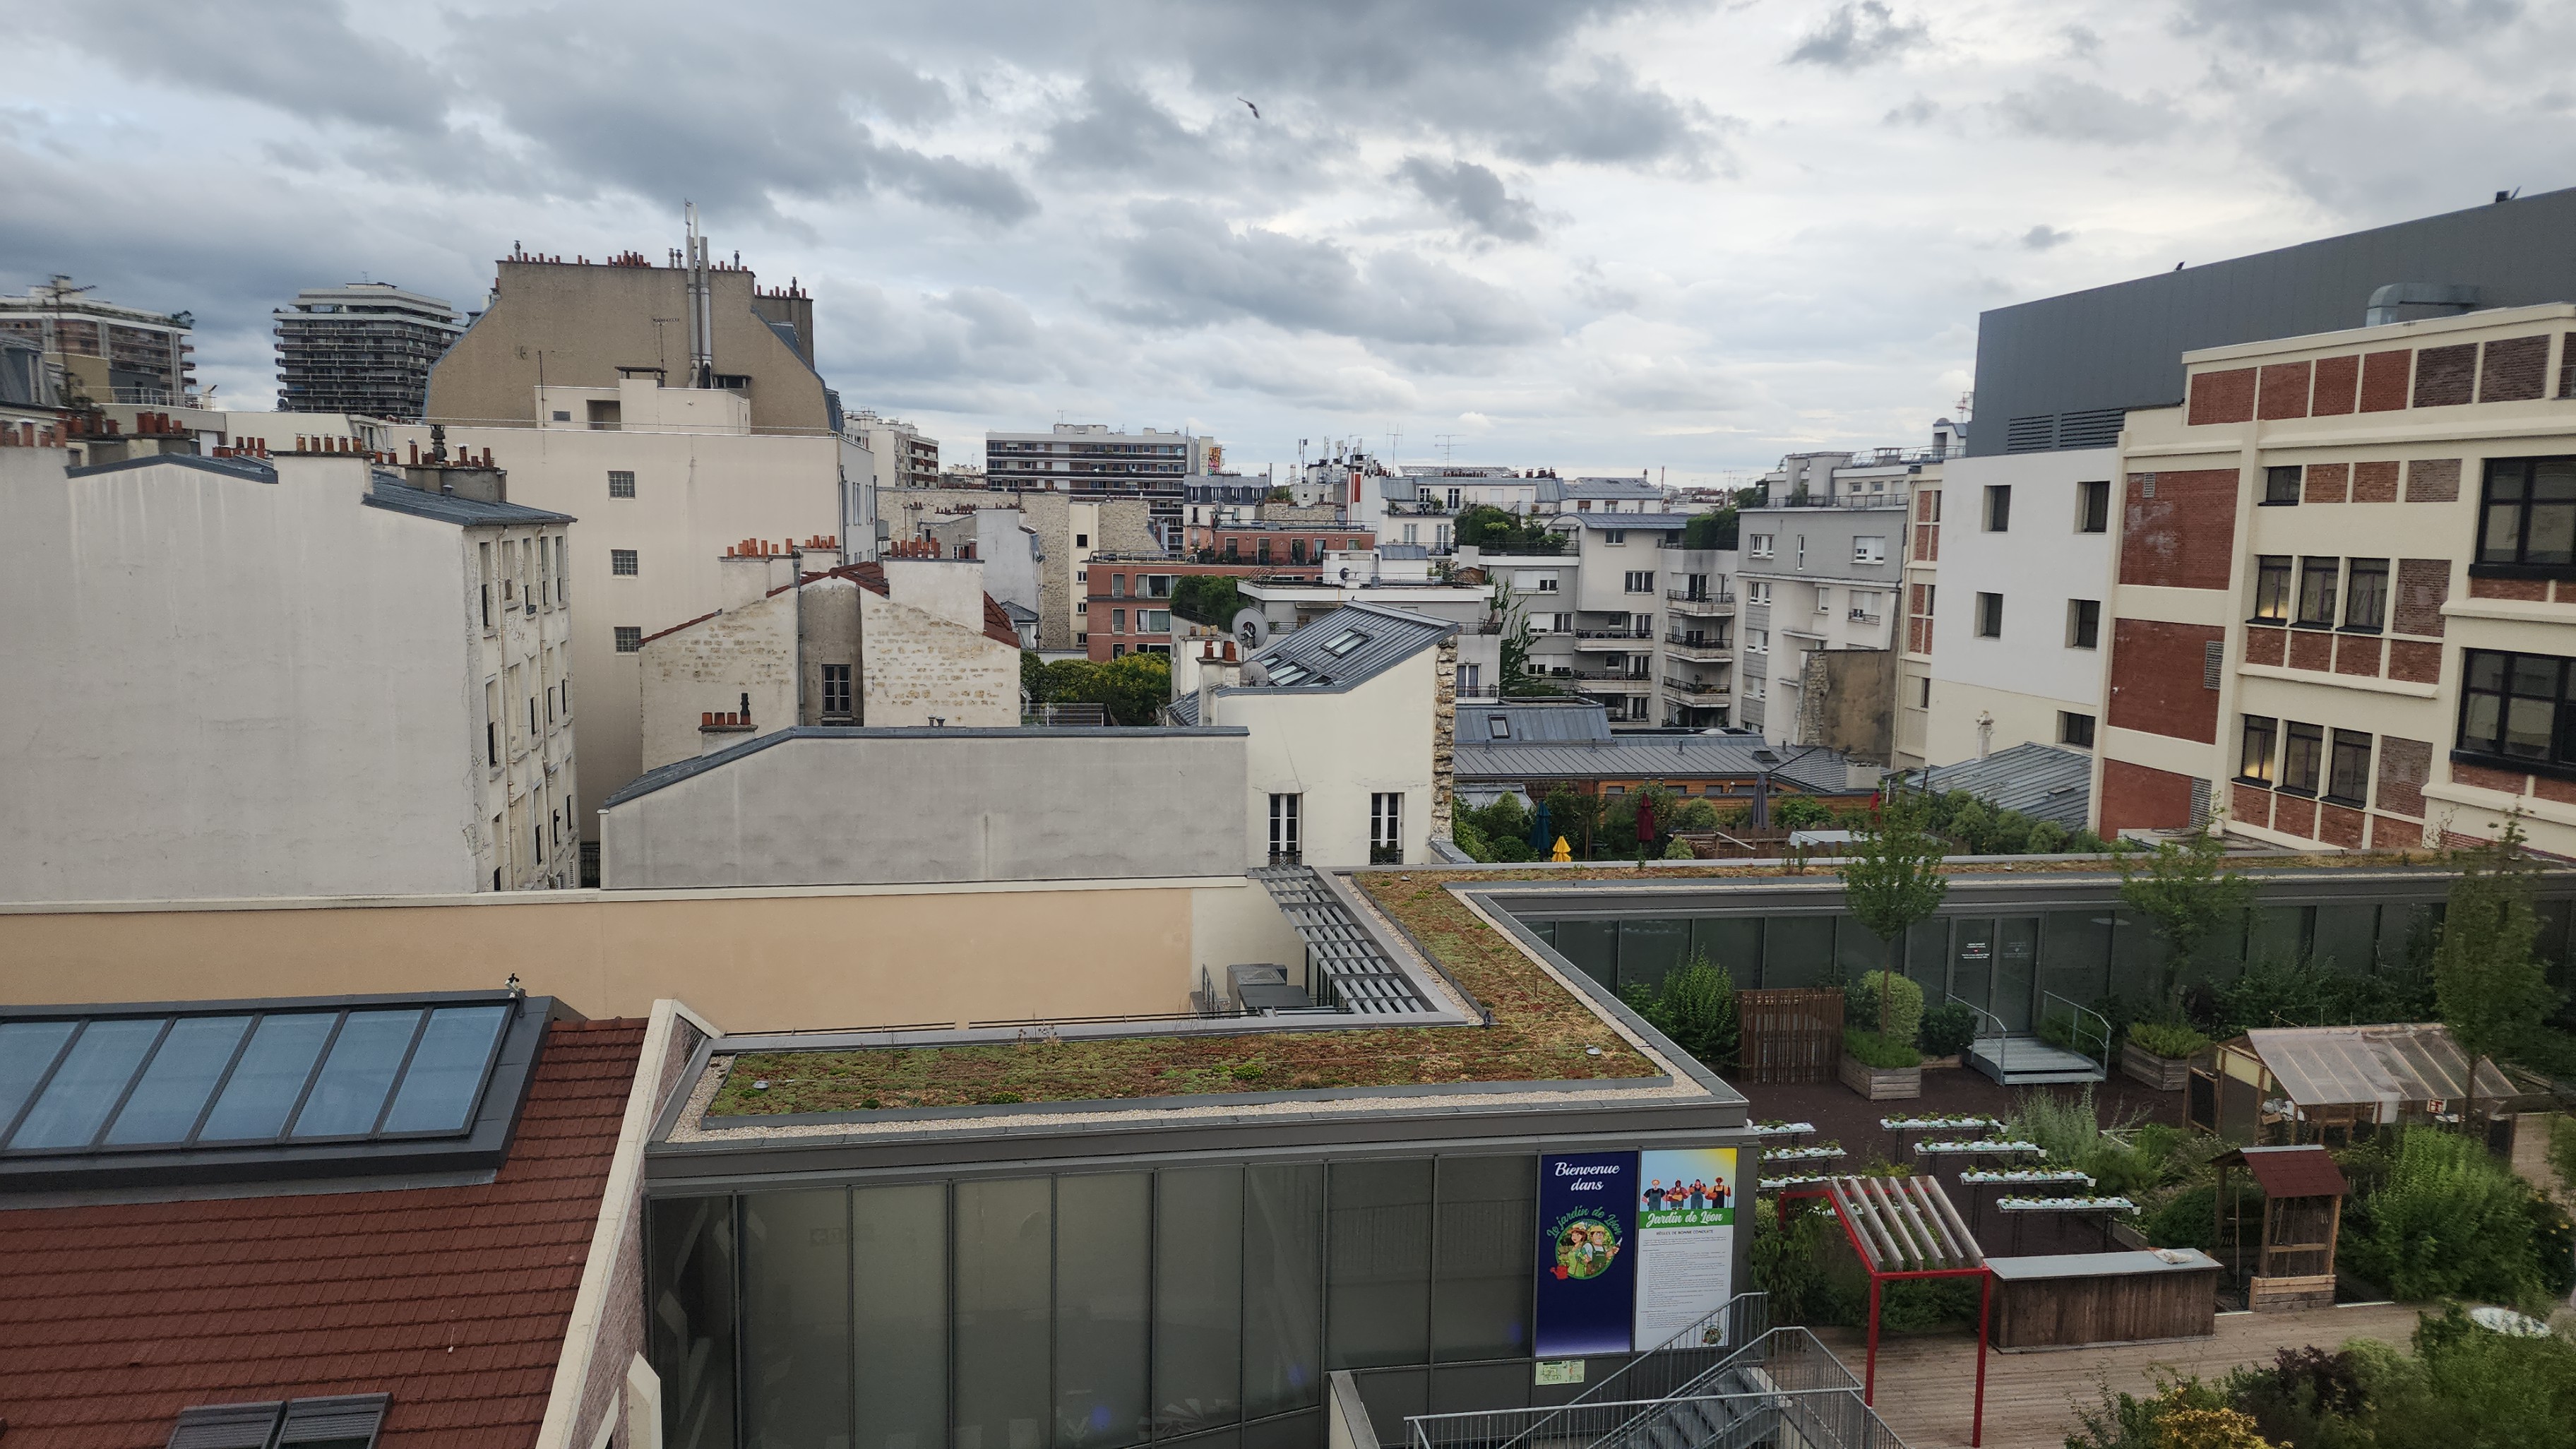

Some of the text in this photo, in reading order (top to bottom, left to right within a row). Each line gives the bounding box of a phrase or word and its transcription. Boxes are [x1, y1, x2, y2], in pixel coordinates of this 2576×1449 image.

[1554, 1162, 1621, 1176] Bienvenue
[1570, 1178, 1604, 1191] dans
[1556, 1205, 1590, 1230] jardin
[1592, 1206, 1605, 1218] de
[1645, 1210, 1724, 1228] Jardin de Léon
